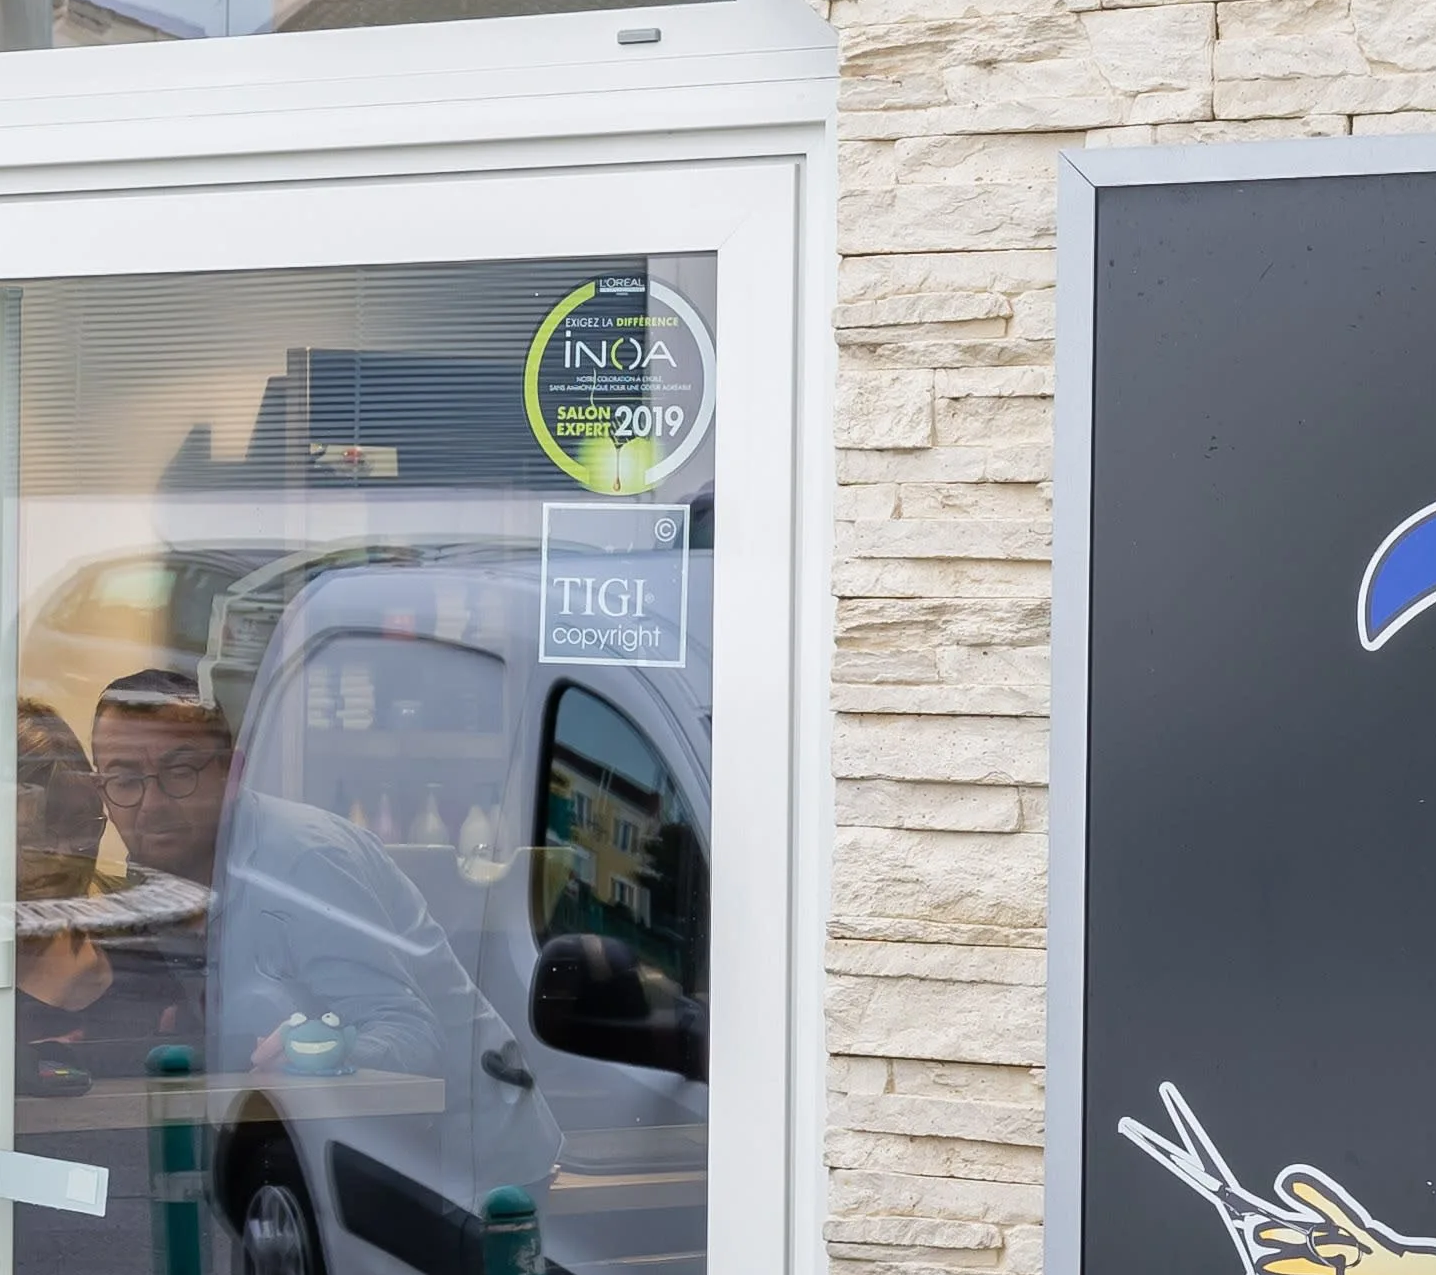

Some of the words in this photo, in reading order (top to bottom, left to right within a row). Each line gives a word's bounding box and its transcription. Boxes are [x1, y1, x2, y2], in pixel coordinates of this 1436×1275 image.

[565, 318, 599, 327] EXIGEZ
[602, 318, 614, 327] LA
[557, 406, 611, 420] SALON
[614, 405, 685, 437] 2019
[556, 422, 611, 437] EXPERT
[552, 624, 662, 652] copyright
